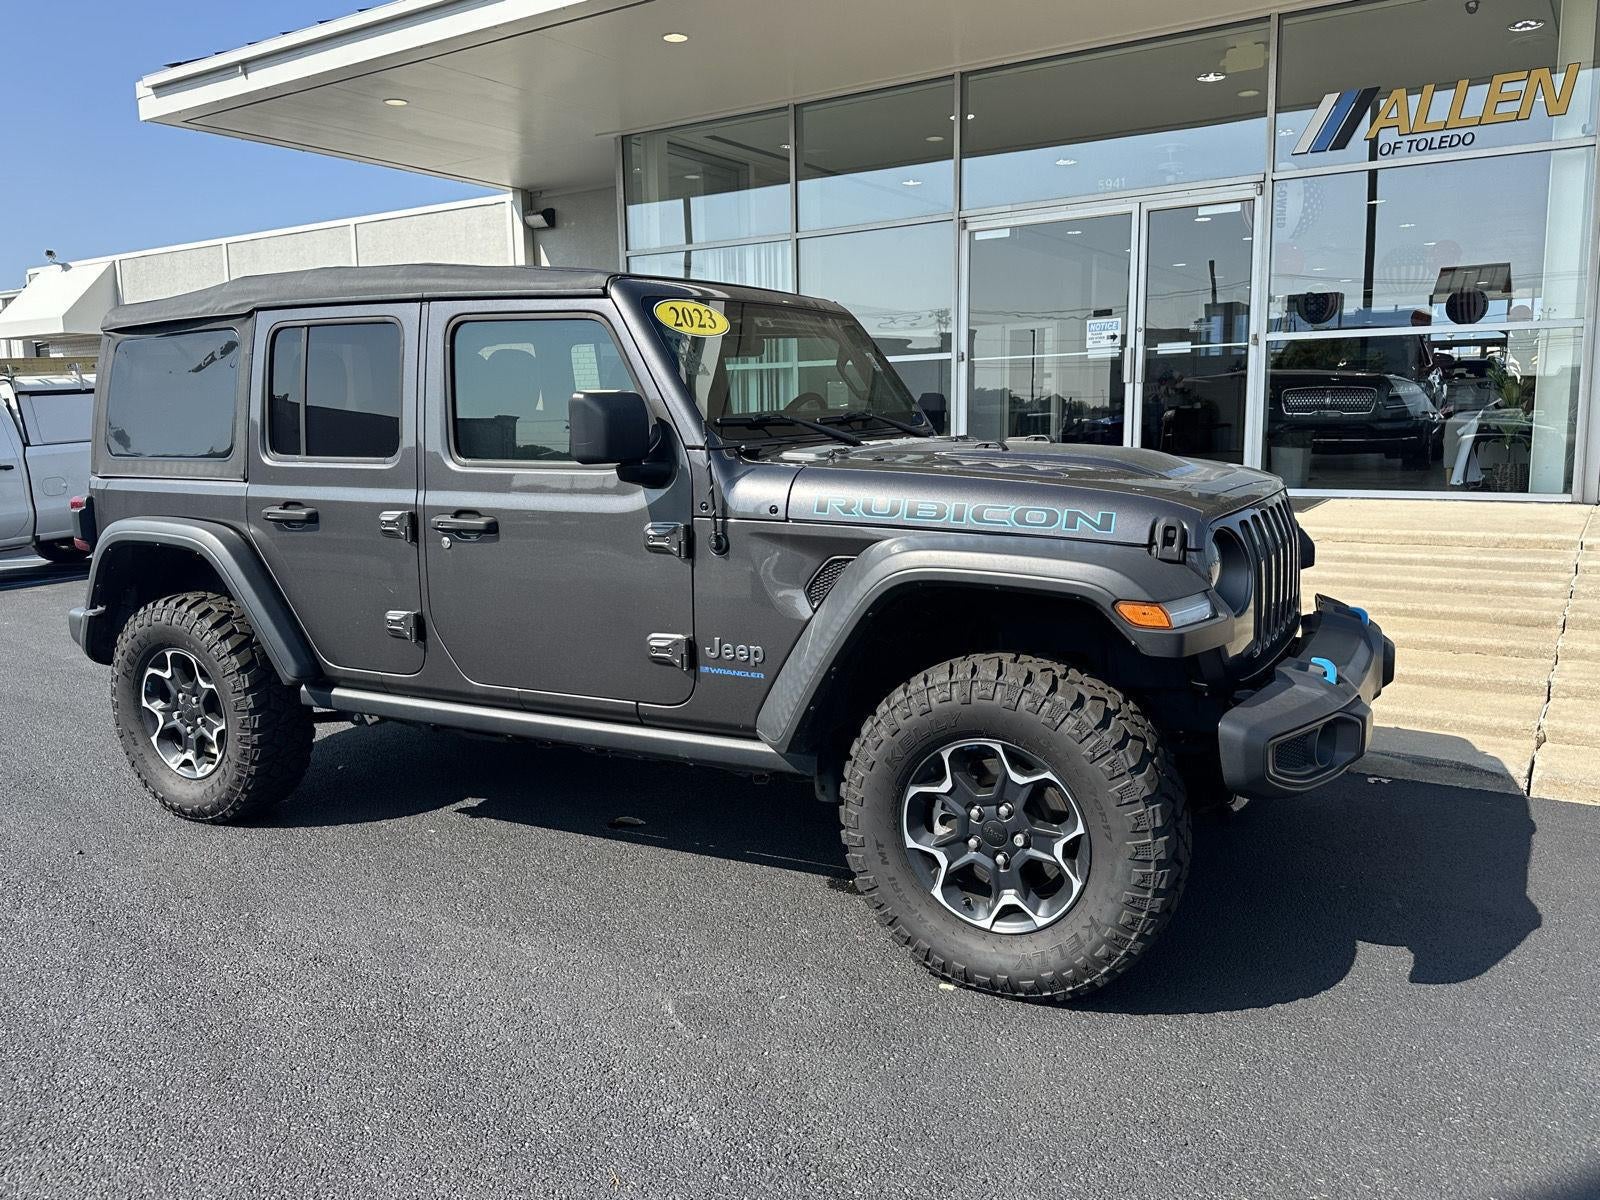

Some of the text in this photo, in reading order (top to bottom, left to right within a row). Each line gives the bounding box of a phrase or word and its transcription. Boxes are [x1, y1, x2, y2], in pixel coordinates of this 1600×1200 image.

[1364, 62, 1582, 141] ALLEN
[1379, 131, 1476, 157] OF TOLEDO
[1097, 177, 1126, 192] 5941
[668, 306, 717, 330] 2023
[1089, 321, 1118, 331] NOTICE
[812, 494, 1117, 534] RUBICON
[704, 636, 765, 667] Jeep
[708, 667, 766, 680] WRANGLER
[884, 711, 962, 776] KELLY
[874, 835, 890, 866] MT
[1014, 915, 1101, 971] KELLY
